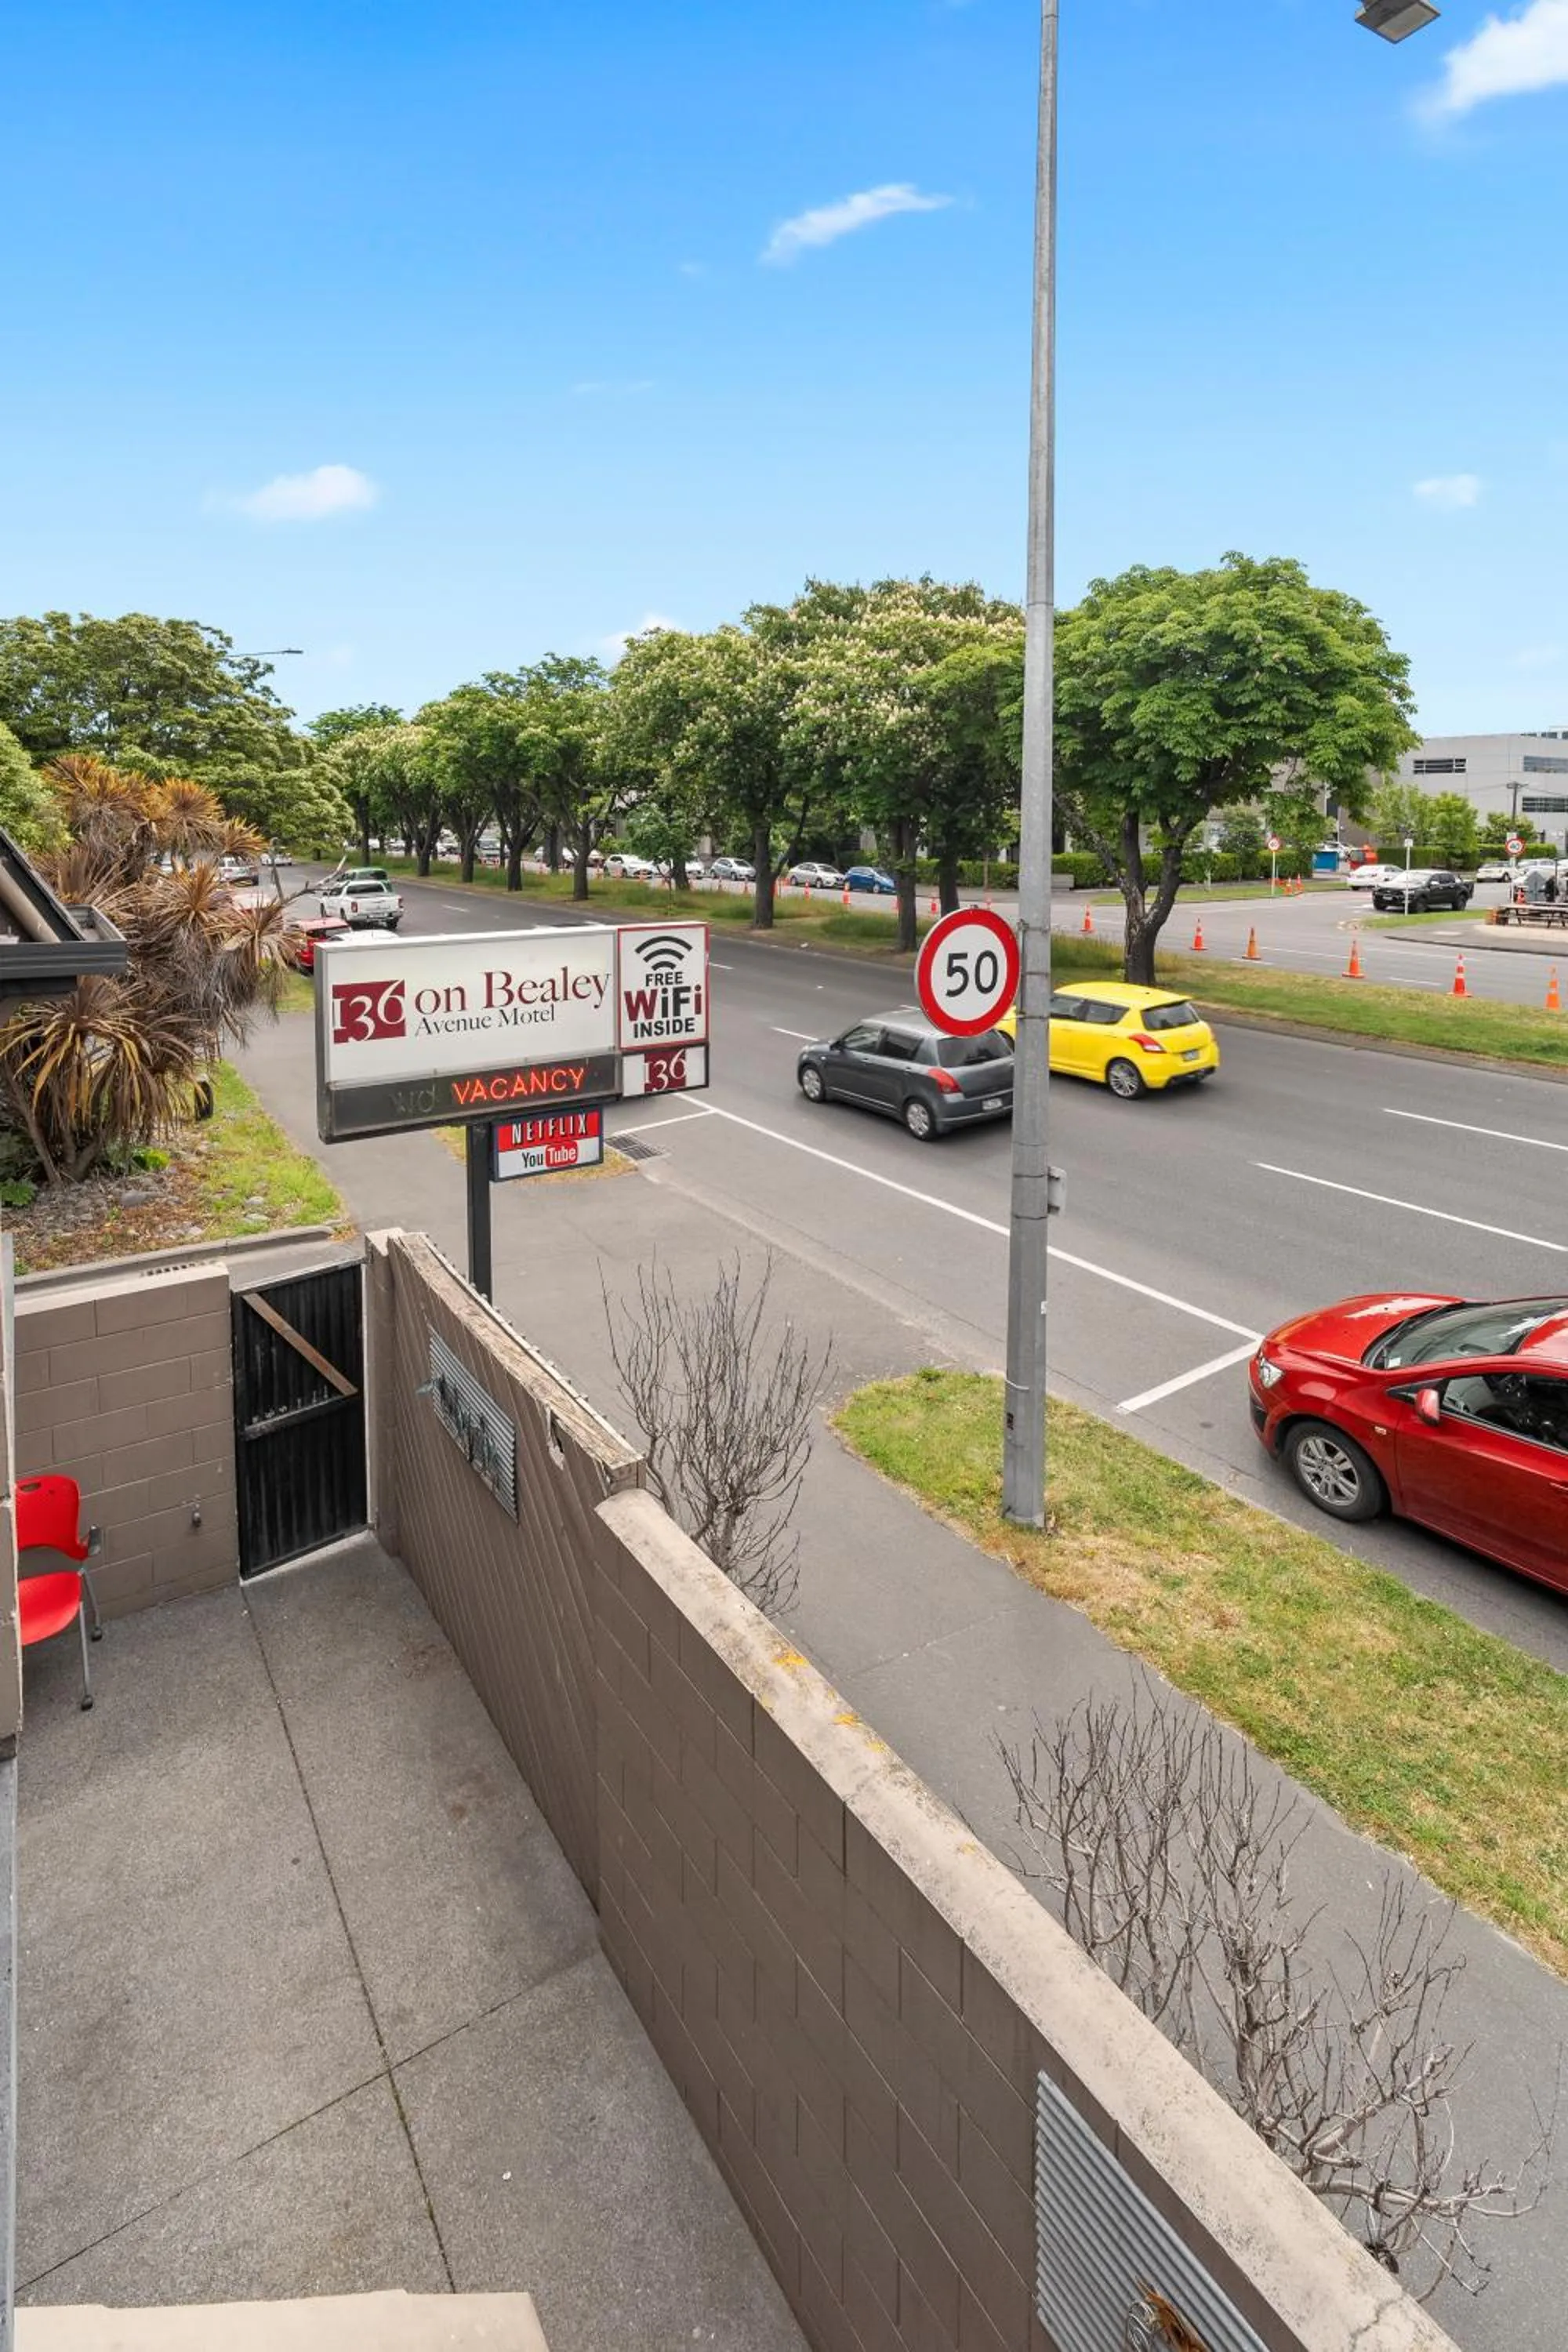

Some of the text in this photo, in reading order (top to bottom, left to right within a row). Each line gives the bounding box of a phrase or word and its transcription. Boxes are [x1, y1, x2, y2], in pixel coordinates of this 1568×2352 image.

[645, 971, 684, 987] FREE
[946, 950, 998, 997] 50
[332, 966, 611, 1041] 136 on Bealey
[416, 1004, 555, 1036] Avenue Motel
[624, 985, 702, 1022] WiFi
[633, 1018, 695, 1038] INSIDE
[452, 1067, 585, 1105] VACANCY
[644, 1048, 687, 1093] 136
[512, 1113, 586, 1144] NETFLIX
